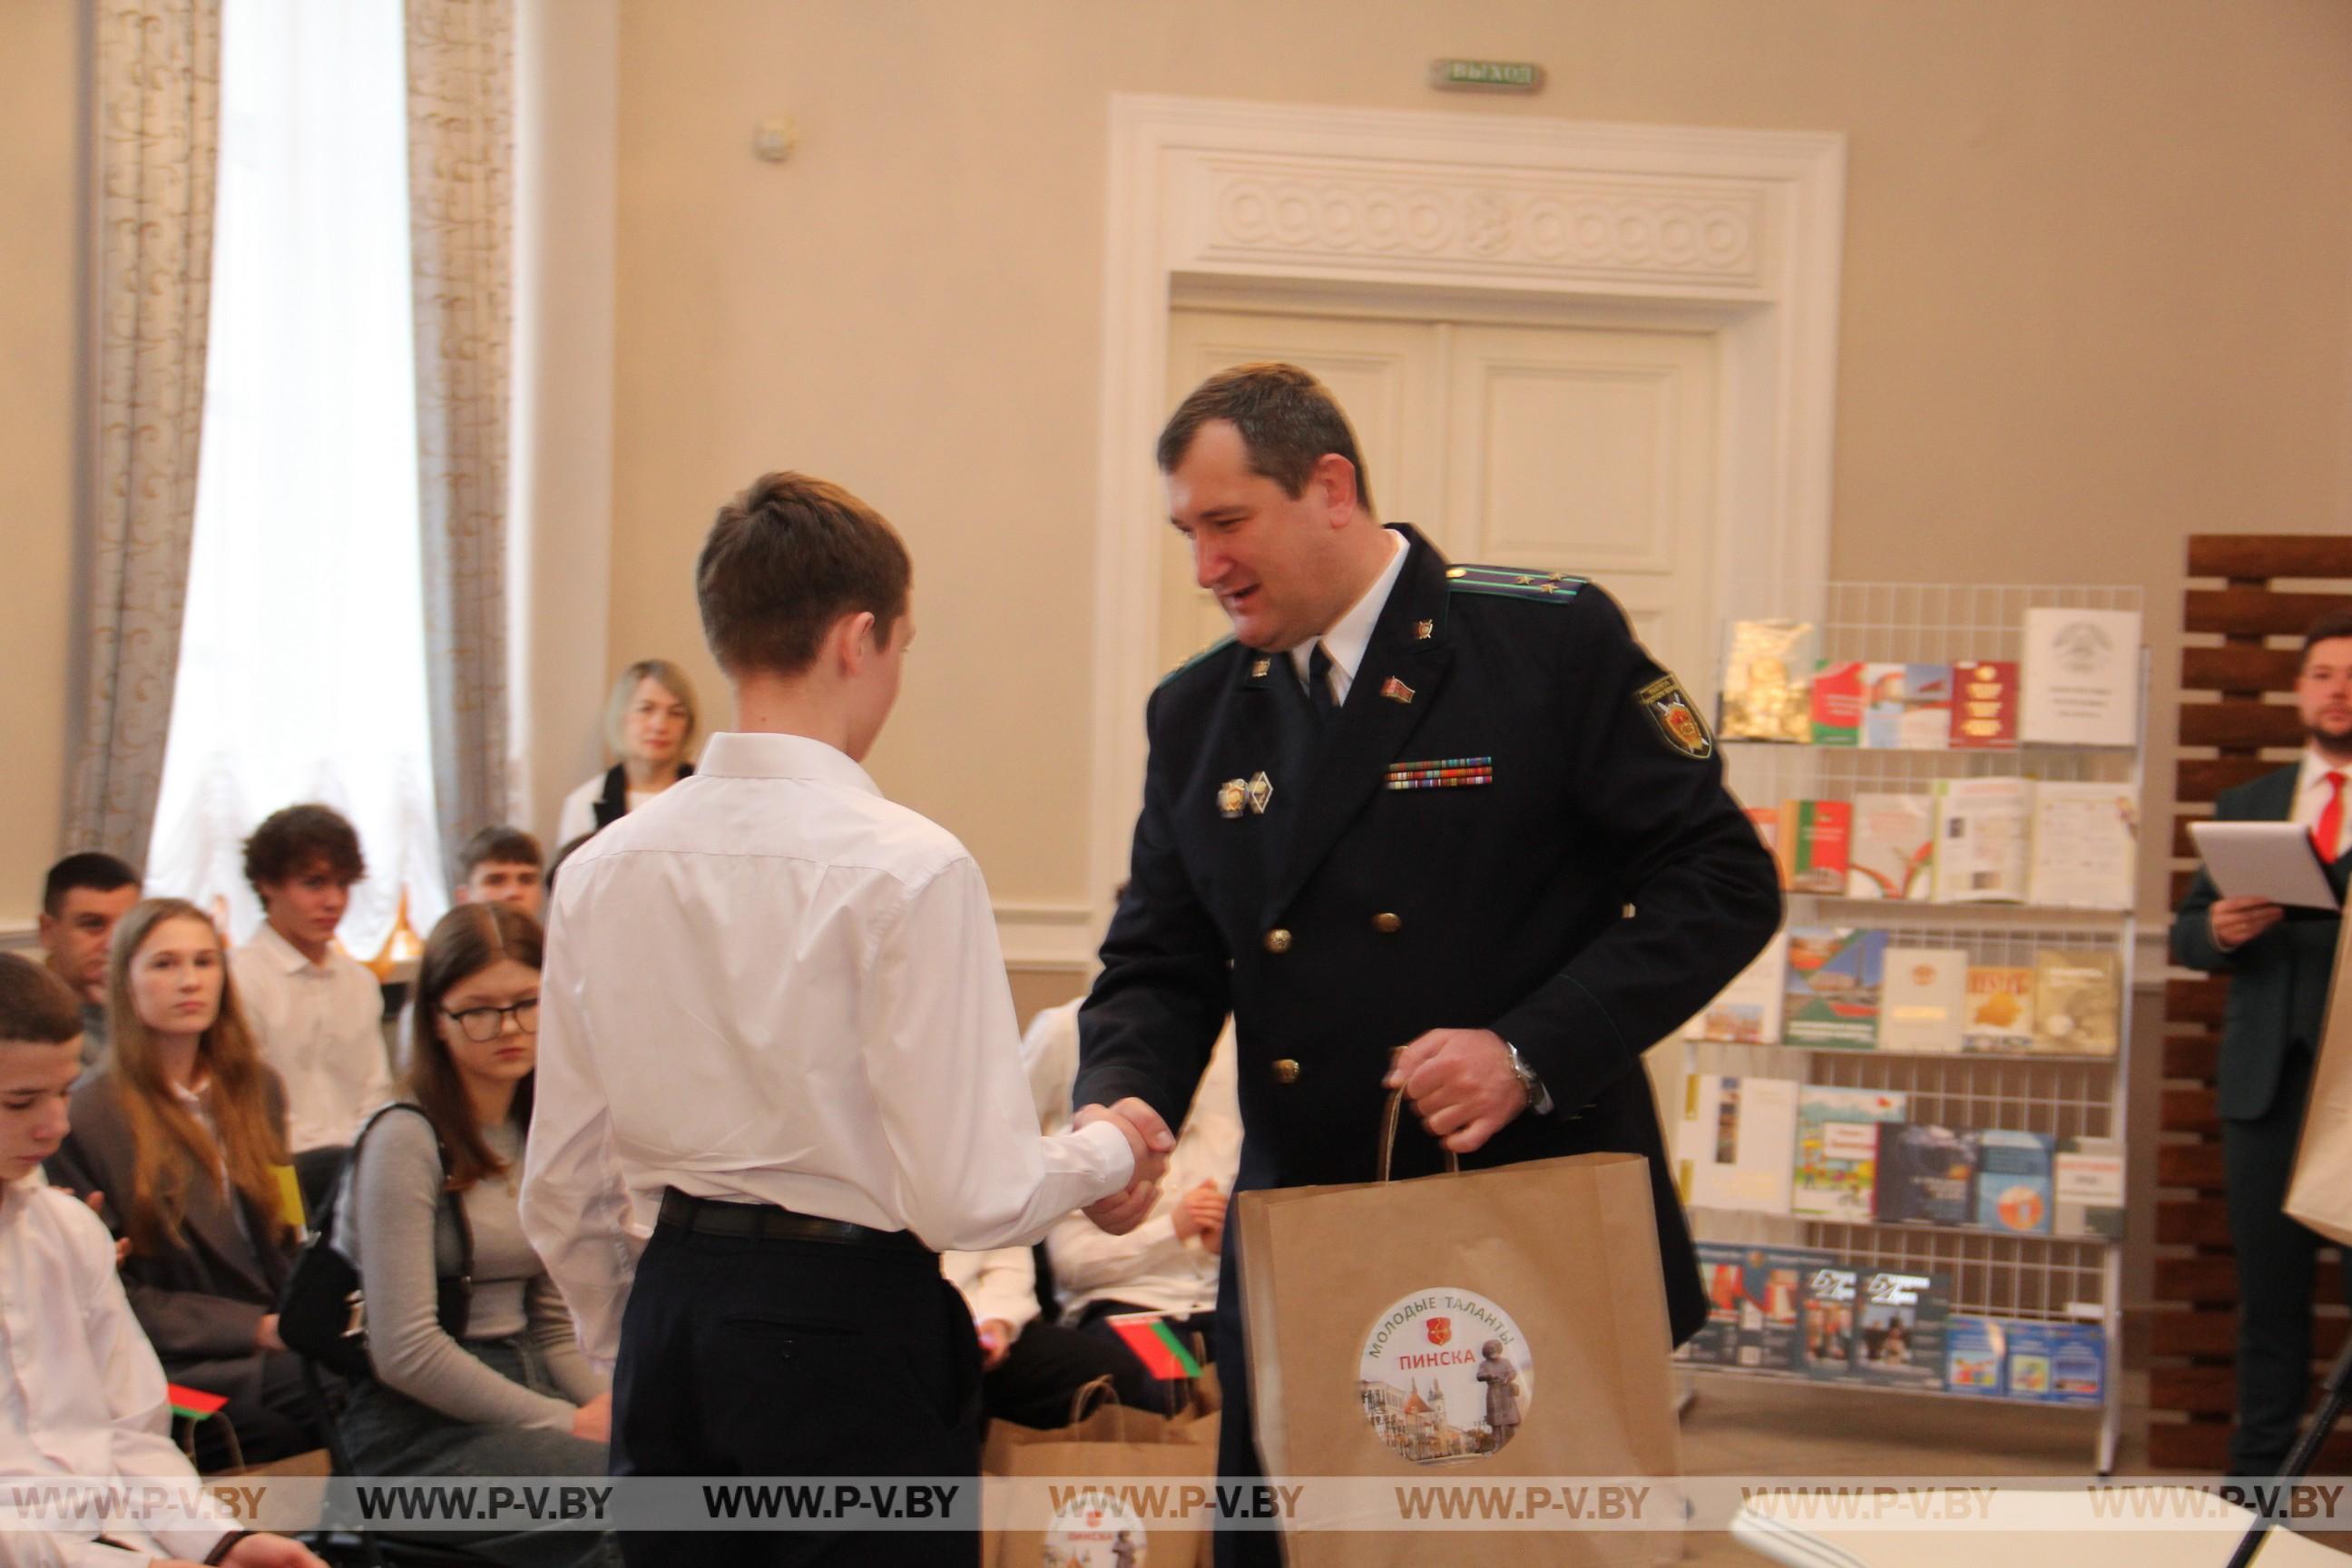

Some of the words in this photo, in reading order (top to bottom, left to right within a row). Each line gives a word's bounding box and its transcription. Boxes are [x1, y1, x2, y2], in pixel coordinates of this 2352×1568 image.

[1453, 63, 1532, 83] ВЫХОД
[1368, 1297, 1437, 1358] МОЛОДЫЕ
[1445, 1296, 1515, 1345] ТАЛАНТЫ
[1399, 1349, 1475, 1370] ПИНСКА
